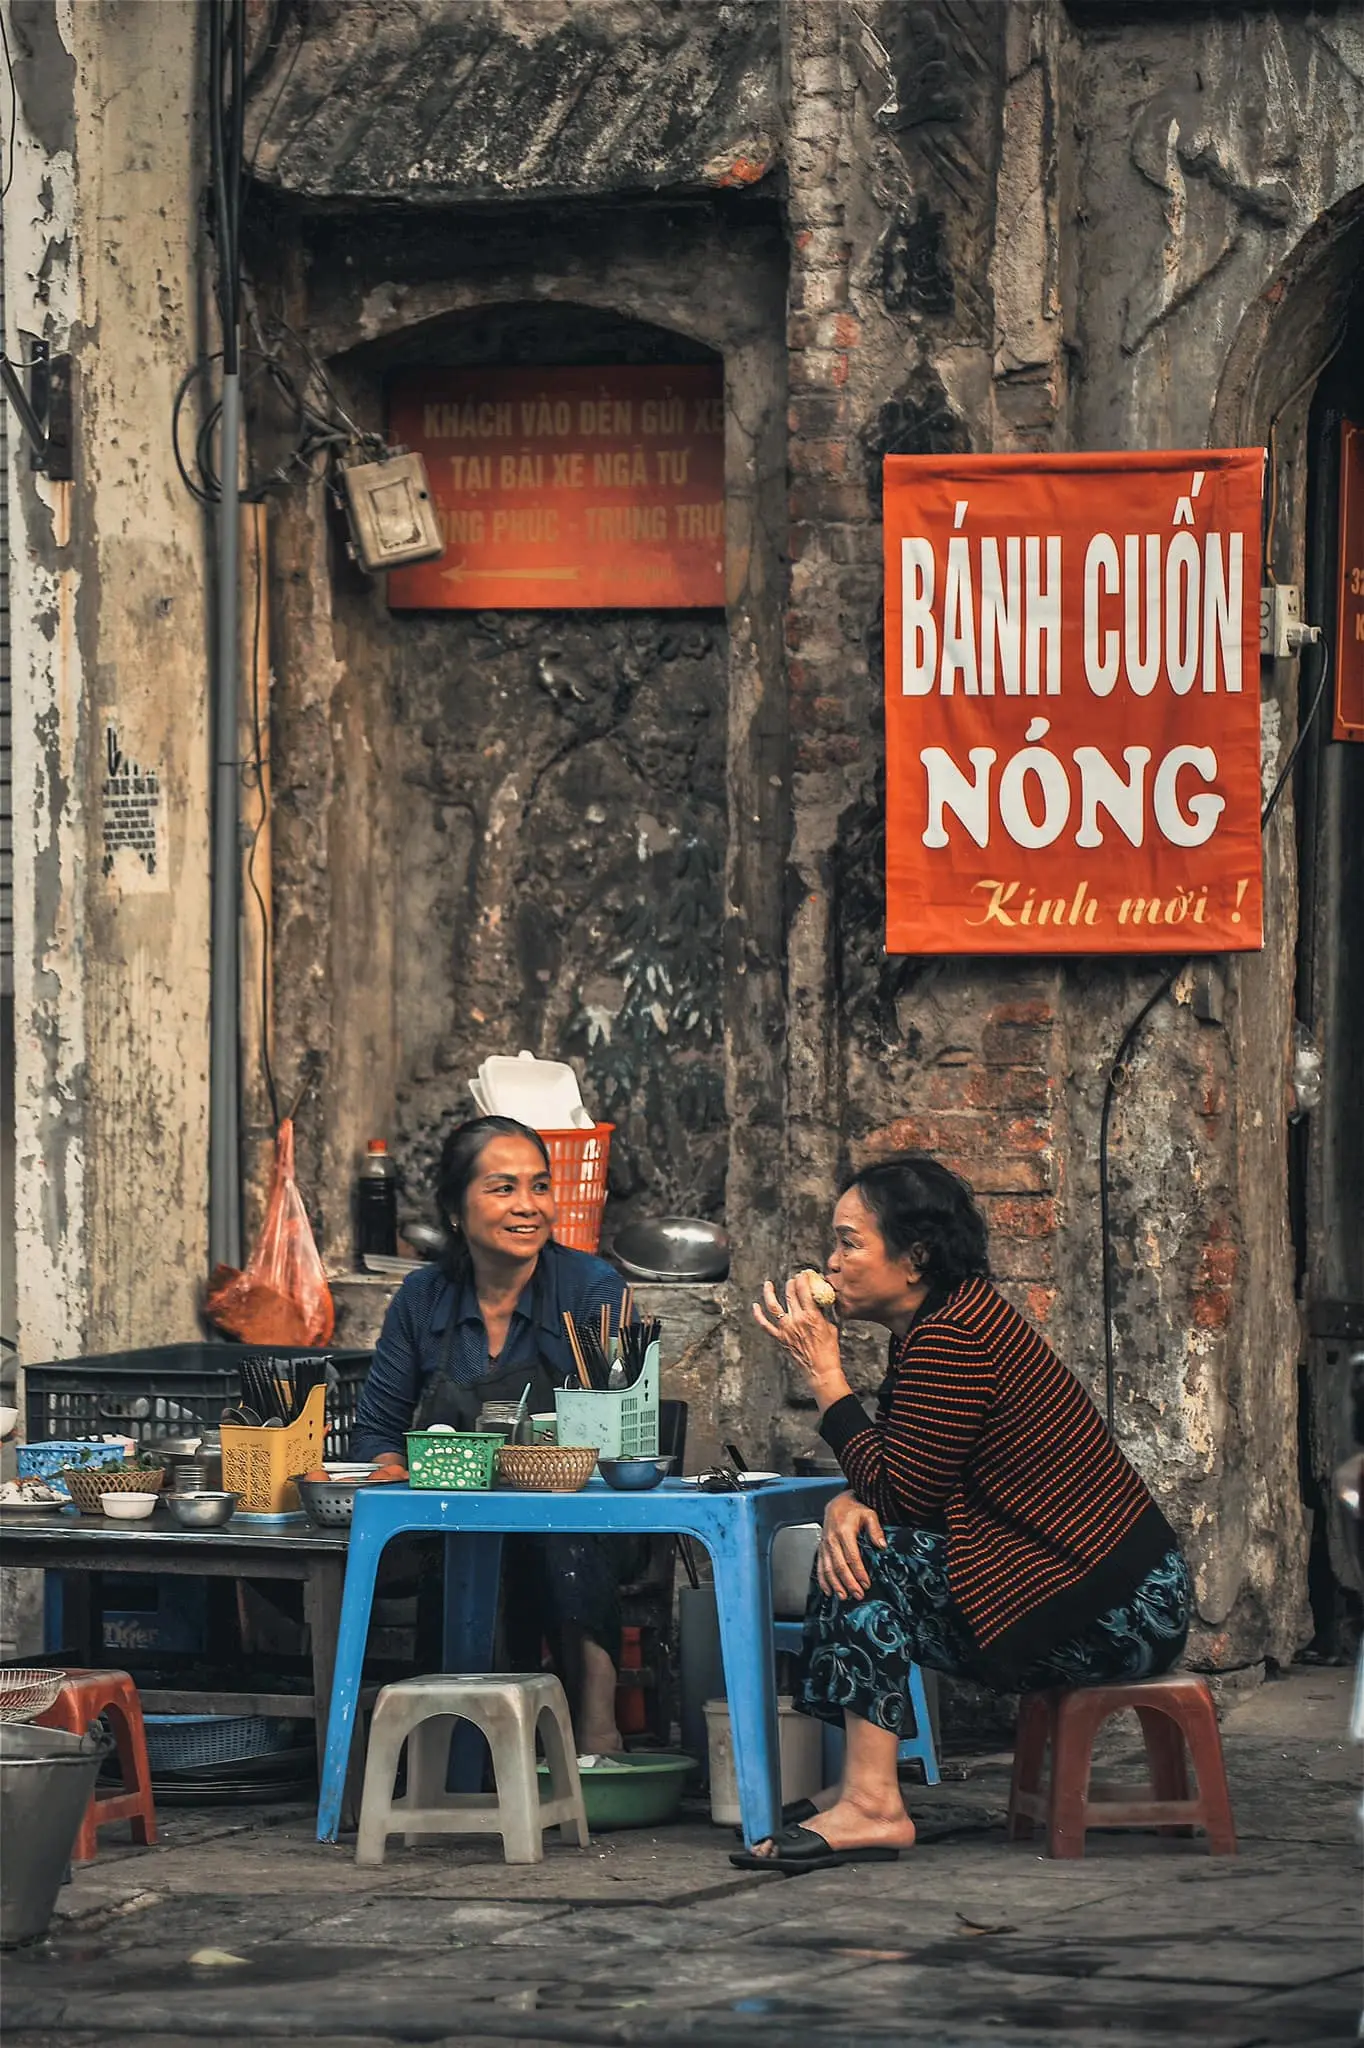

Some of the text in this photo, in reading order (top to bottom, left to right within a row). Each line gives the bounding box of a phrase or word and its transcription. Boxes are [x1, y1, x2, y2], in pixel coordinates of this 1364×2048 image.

[423, 392, 513, 438] KHÁCH
[521, 391, 570, 438] VÀO
[552, 453, 585, 489] XE
[583, 504, 668, 544] TRUNG
[901, 471, 1244, 697] BÁNH CUỐN
[919, 716, 1226, 850] NÓNG
[1117, 884, 1212, 925] mời
